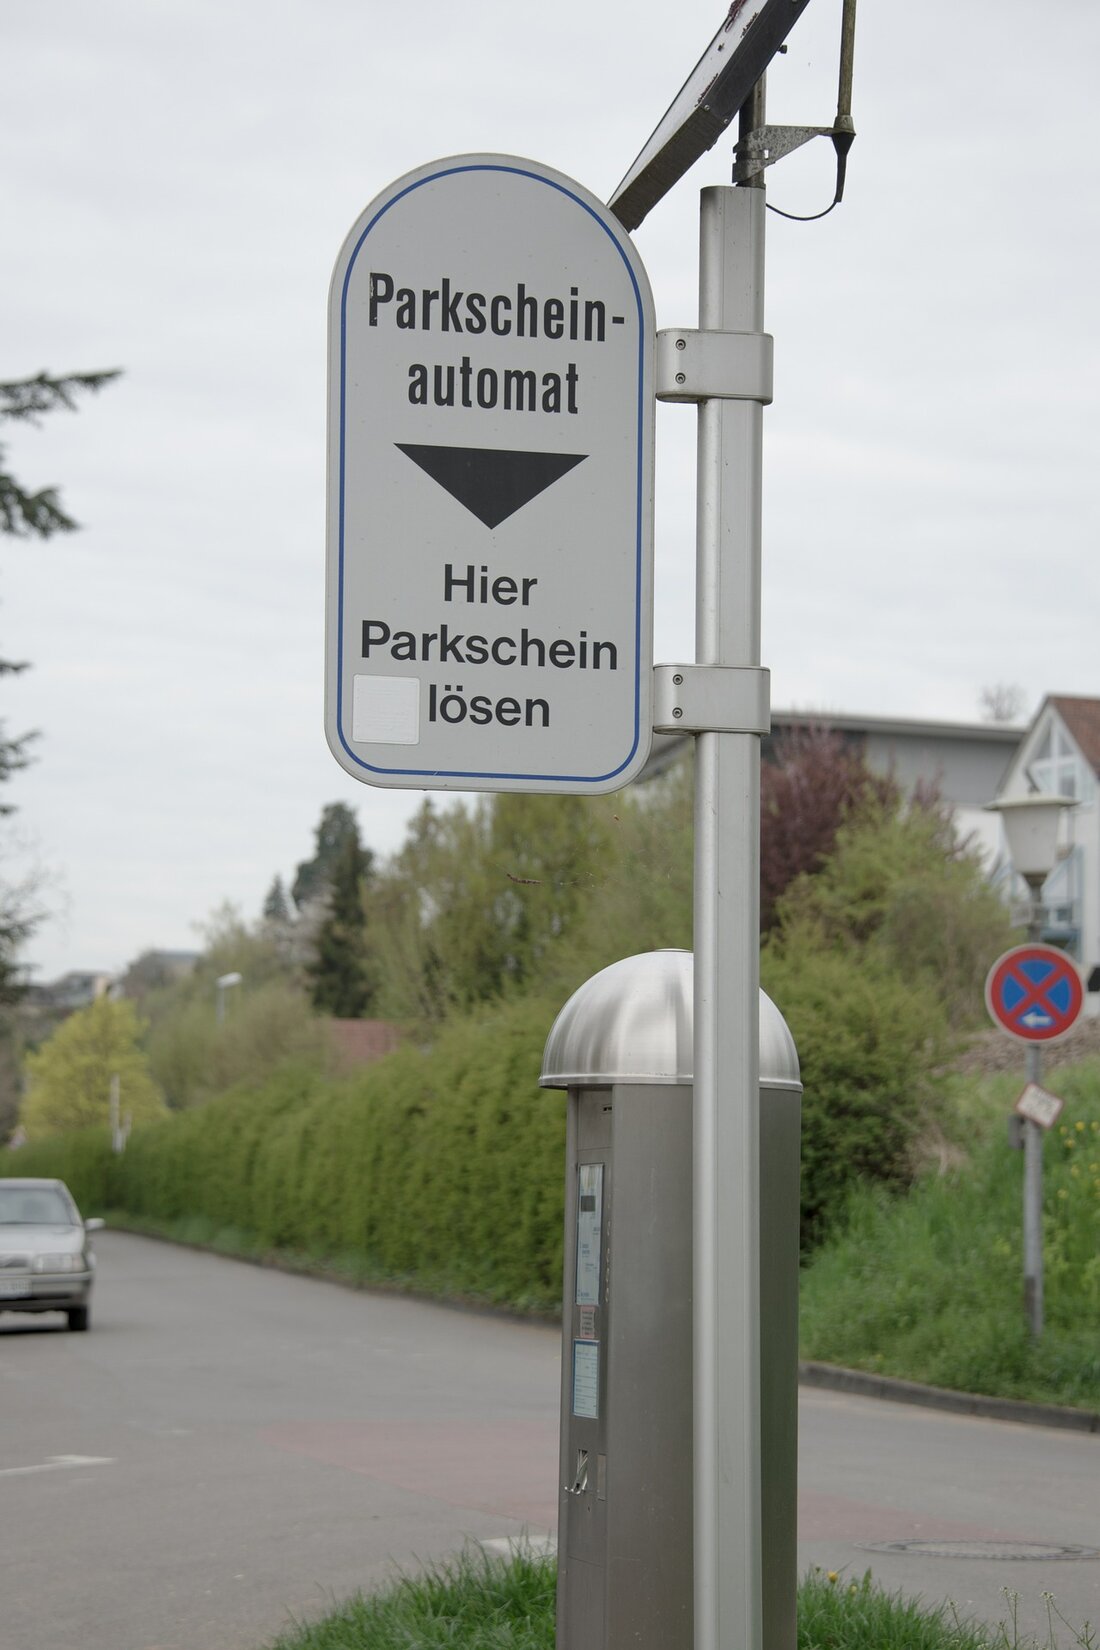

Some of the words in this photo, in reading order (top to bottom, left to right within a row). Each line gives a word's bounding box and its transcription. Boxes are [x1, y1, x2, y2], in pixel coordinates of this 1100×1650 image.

[368, 272, 626, 342] Parkschein-
[408, 356, 579, 415] automat
[444, 563, 538, 606] Hier
[361, 619, 618, 671] Parkschein
[428, 683, 550, 728] lösen
